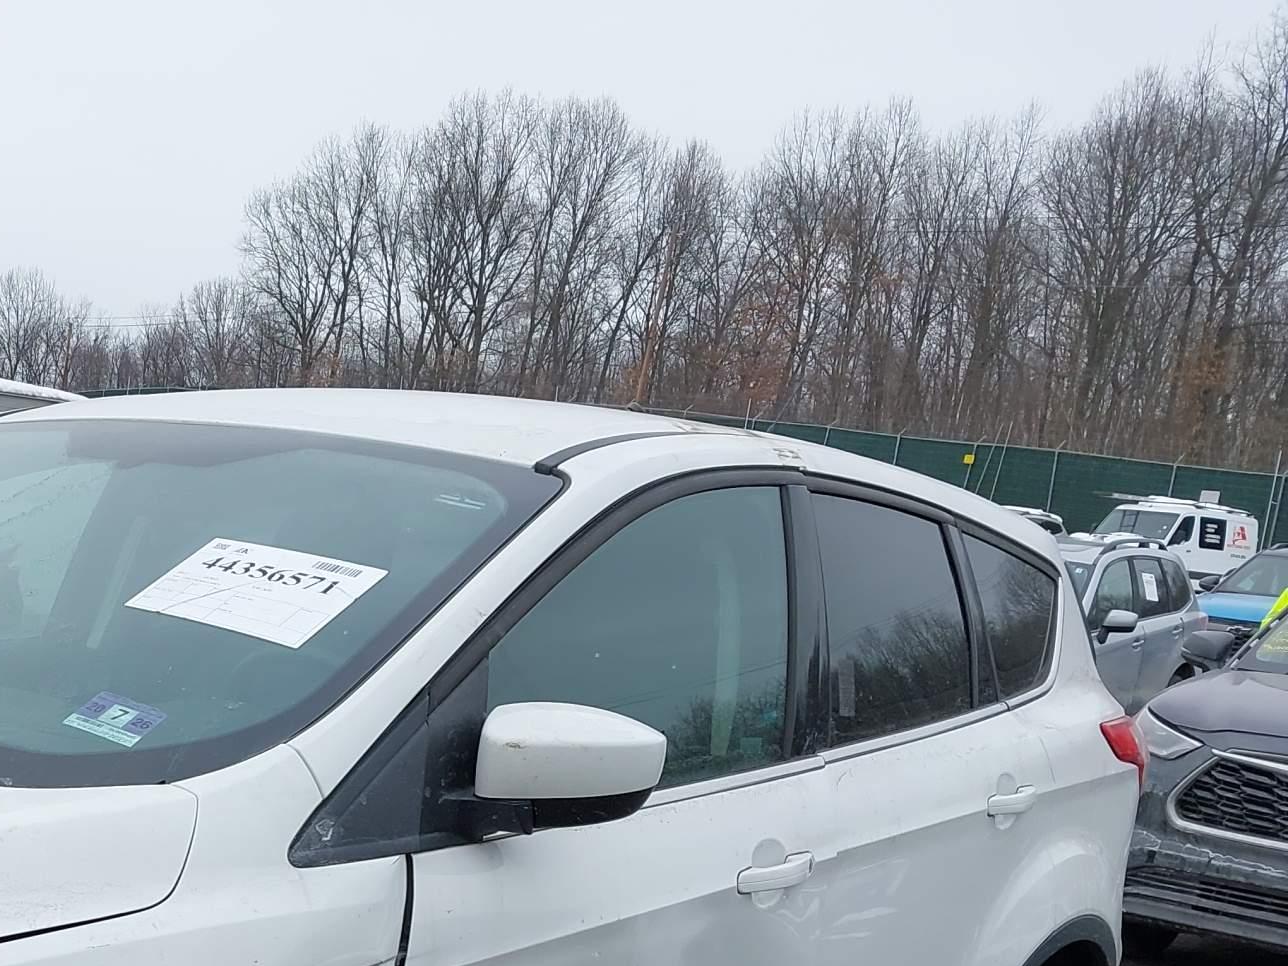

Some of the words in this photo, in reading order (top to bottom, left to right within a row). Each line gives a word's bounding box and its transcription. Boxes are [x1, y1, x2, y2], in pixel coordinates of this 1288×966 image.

[202, 557, 341, 595] 44356571
[85, 702, 106, 713] 20
[111, 708, 130, 720] 7
[131, 718, 153, 730] 26
